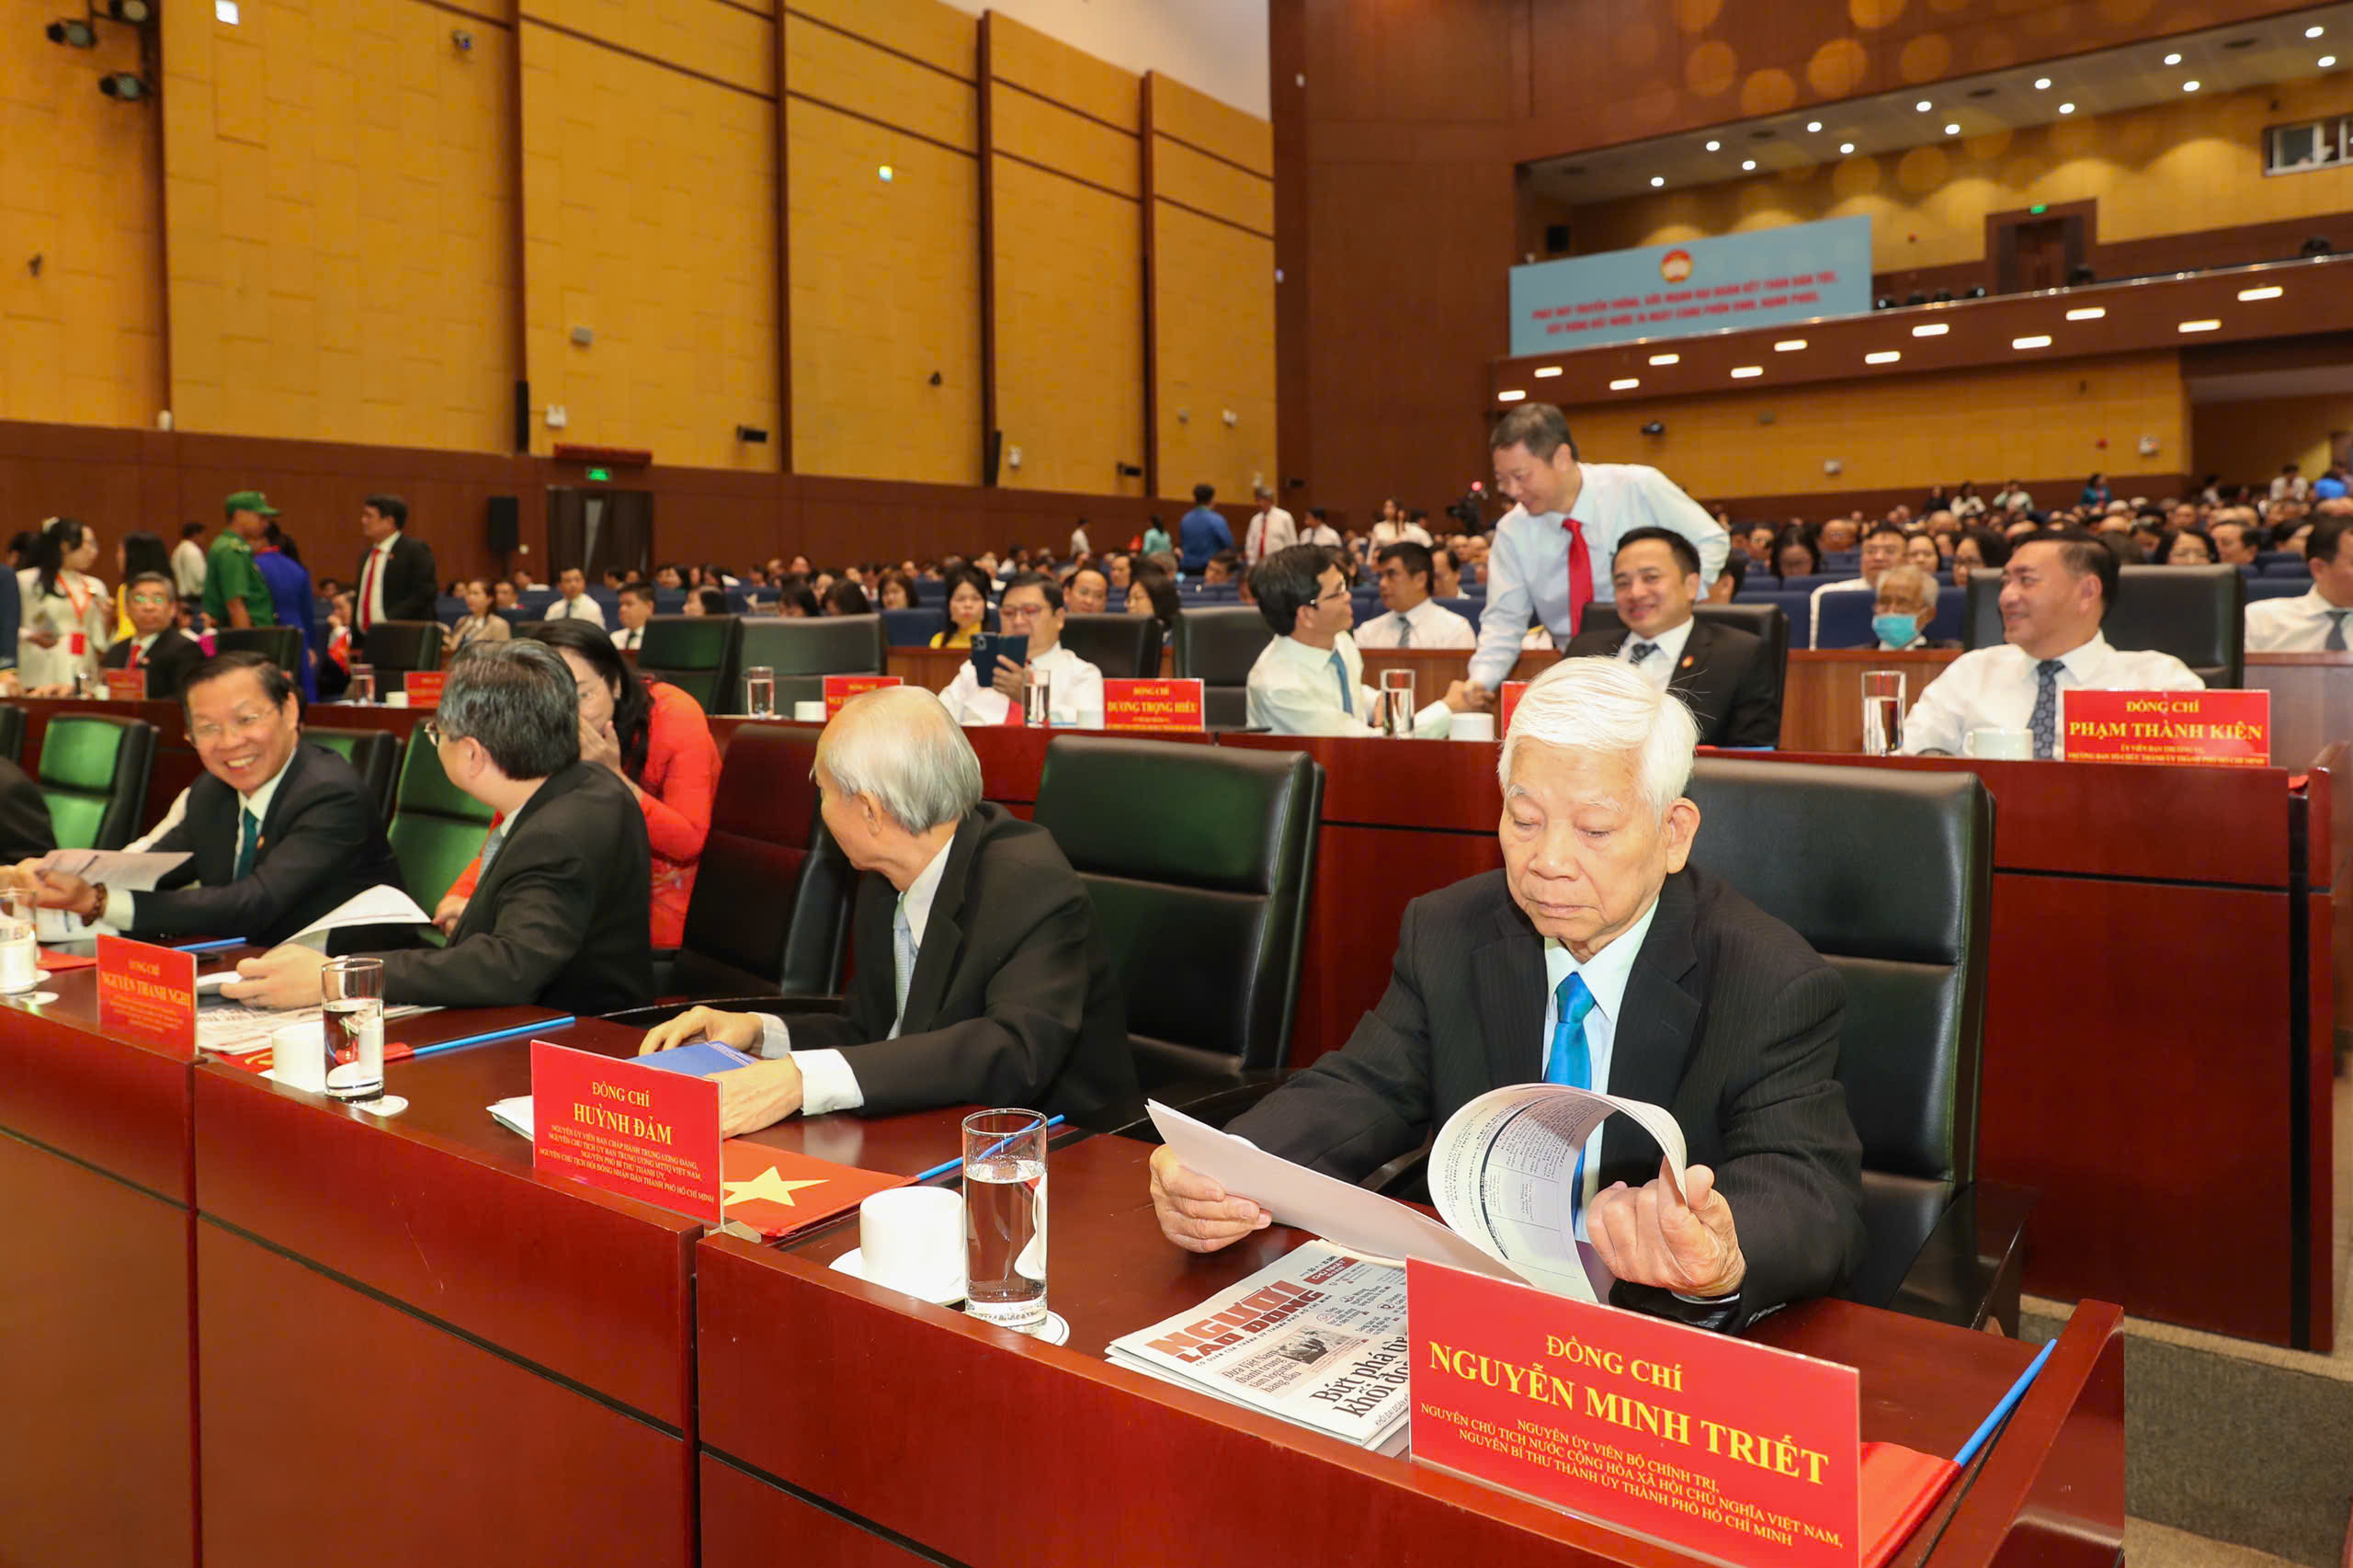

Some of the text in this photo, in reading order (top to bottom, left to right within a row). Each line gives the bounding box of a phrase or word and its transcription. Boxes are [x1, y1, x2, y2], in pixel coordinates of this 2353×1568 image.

[2069, 720, 2263, 740] PHẠM THÀNH KIÊN
[2126, 699, 2200, 713] ĐỒNG CHÍ
[574, 1103, 672, 1145] HUỲNH ĐẢM
[628, 1090, 651, 1107] CHÍ
[1145, 1279, 1308, 1356] NGƯỜI
[1176, 1333, 1245, 1363] LAO
[1241, 1290, 1325, 1334] ĐỘNG
[1309, 1377, 1365, 1403] Bứt
[1350, 1352, 1398, 1380] phá
[1546, 1333, 1684, 1392] ĐỒNG CHÍ
[1333, 1383, 1397, 1418] khối
[1428, 1341, 1574, 1411] NGUYỄN
[1585, 1385, 1692, 1447] MINH
[1700, 1419, 1829, 1486] TRIẾT
[1421, 1403, 1844, 1549] NGUYÊN CHỦ TỊCH NƯỚC CỘNG HÒA XÃ HỘI CHỦ NGHĨA VIỆT NAM,
[1518, 1418, 1720, 1494] NGUYÊN ỦY VIÊN BỘ CHÍNH TRỊ,
[1459, 1428, 1792, 1546] NGUYÊN BÍ THƯ THÀNH ỦY THÀNH PHỐ HỒ CHÍ MINH
